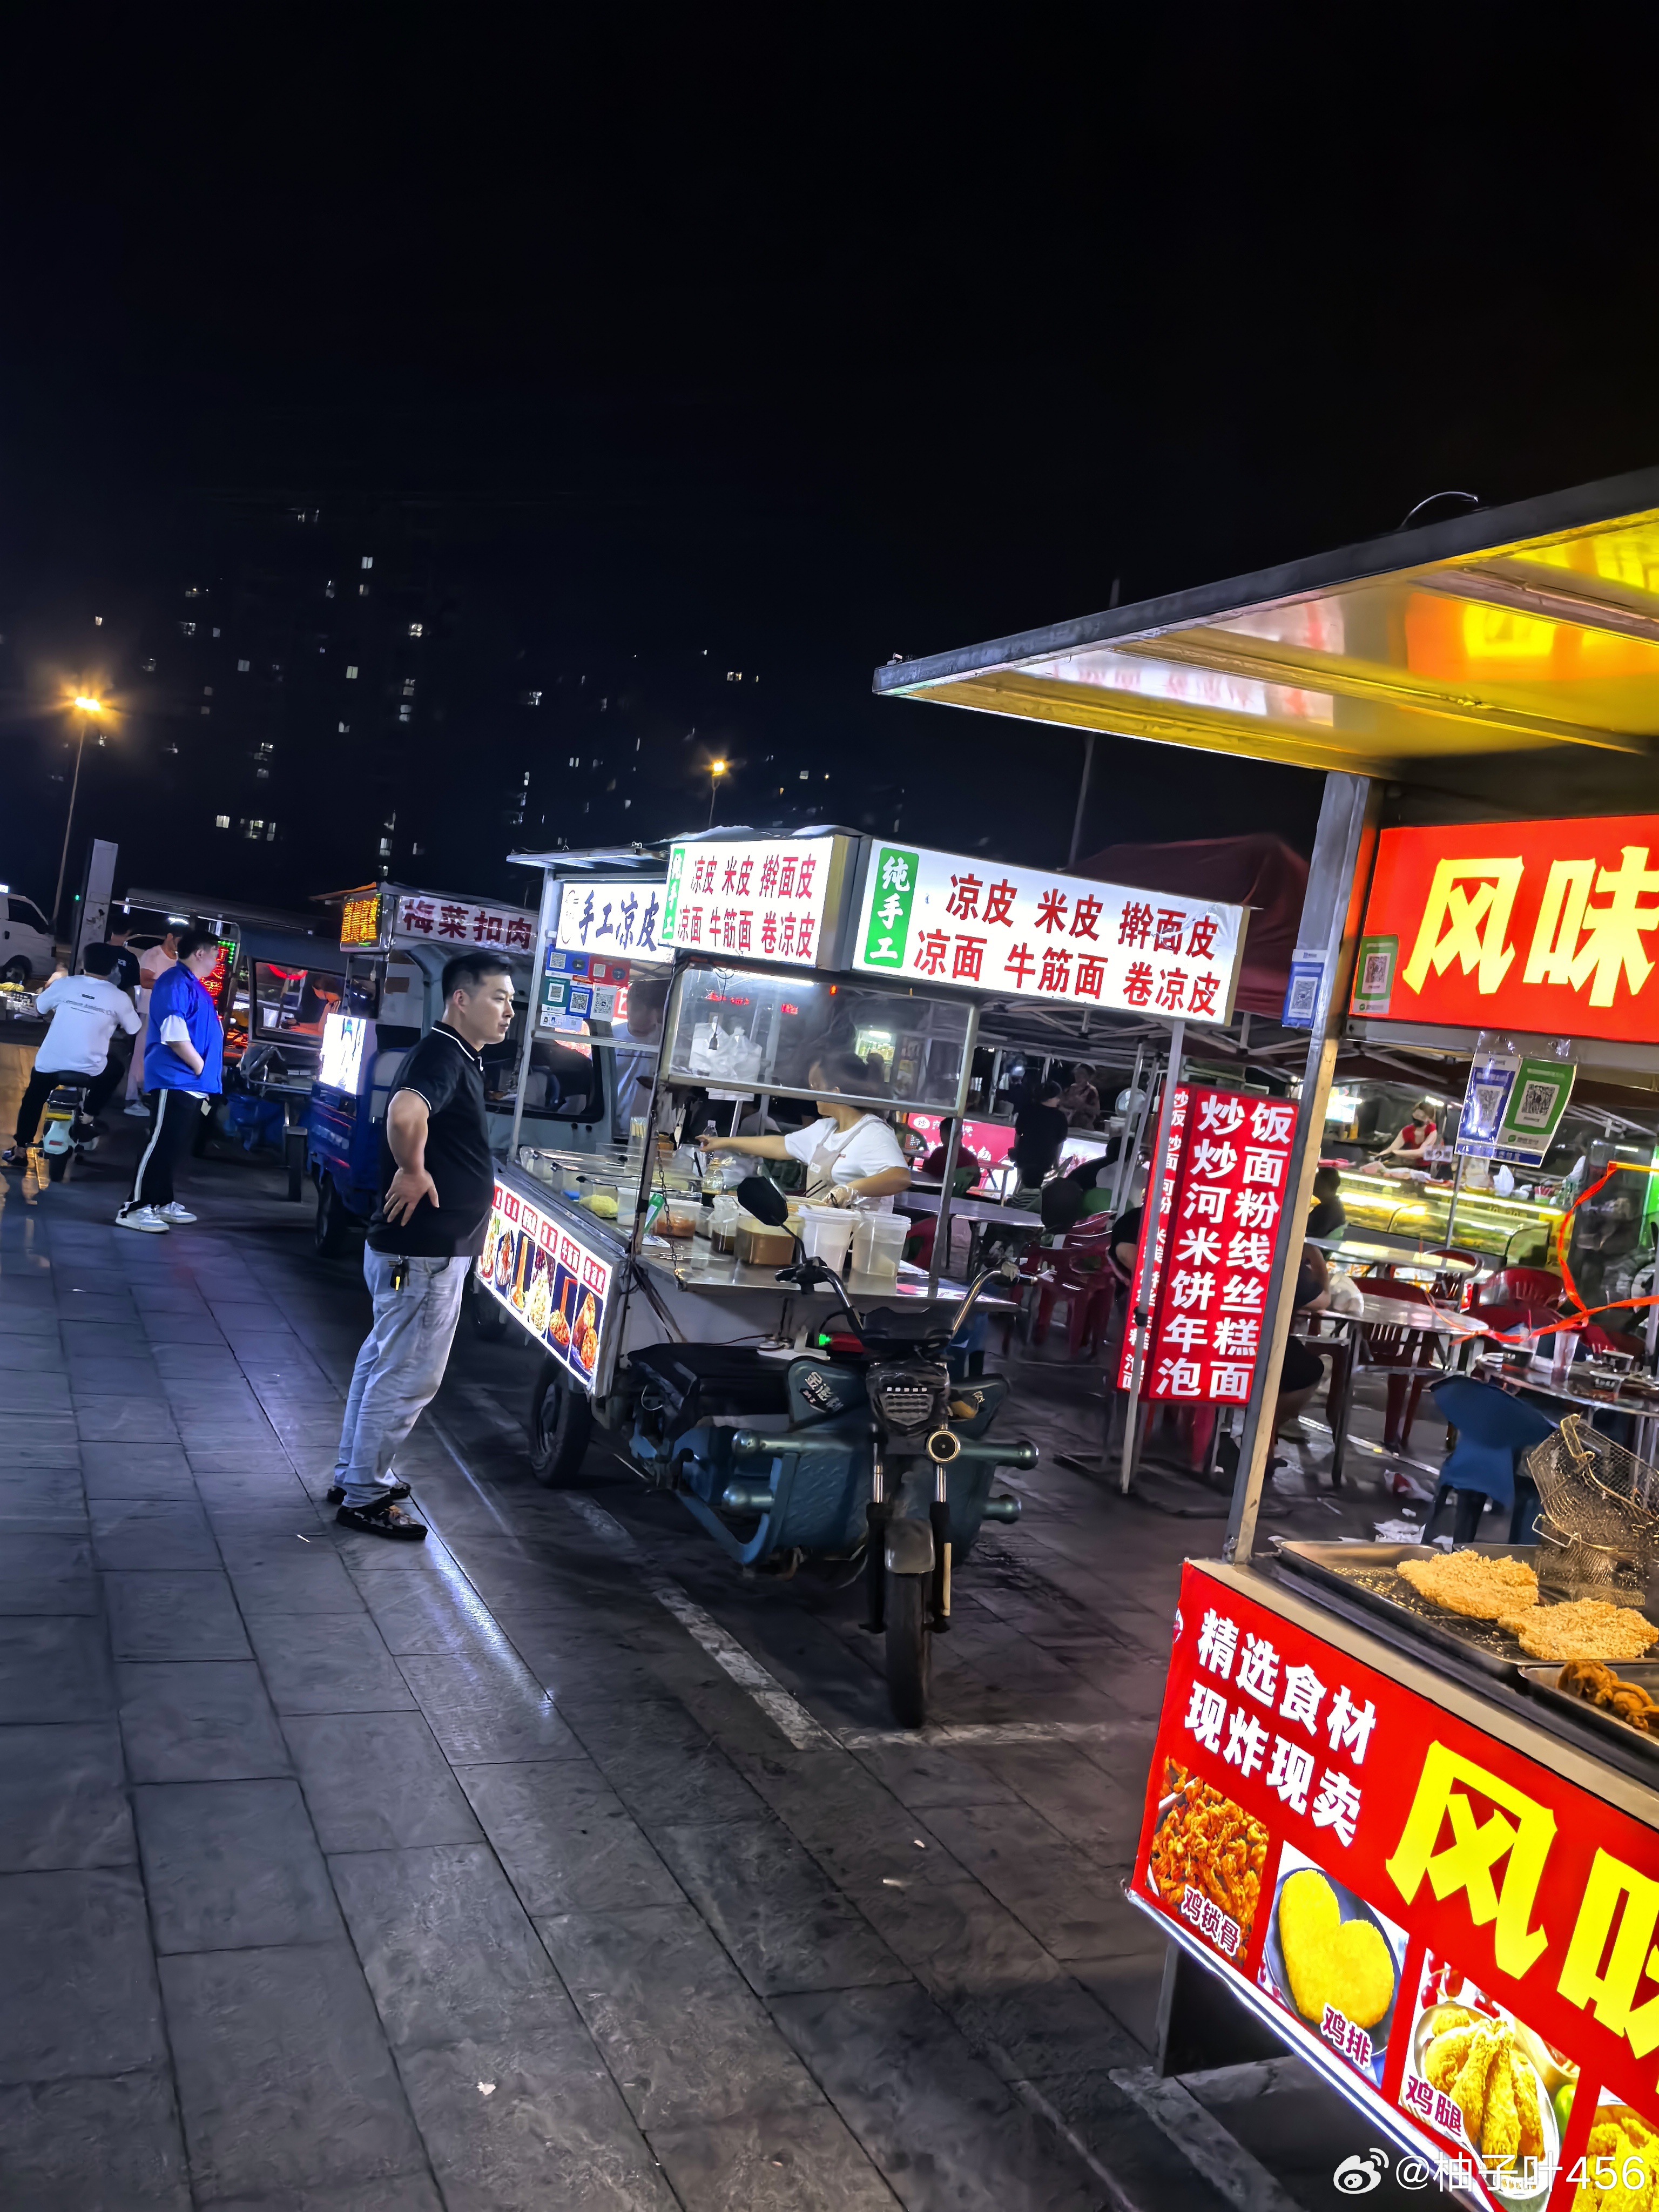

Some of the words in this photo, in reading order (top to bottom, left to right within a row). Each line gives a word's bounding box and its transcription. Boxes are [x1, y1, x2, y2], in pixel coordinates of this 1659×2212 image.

[722, 855, 754, 896] 米皮
[759, 853, 817, 899] 擀面皮
[403, 899, 532, 949] 梅菜扣肉
[579, 889, 659, 952] 手工凉皮
[709, 907, 753, 952] 牛筋面
[761, 911, 815, 959] 卷凉皮
[869, 855, 911, 960] 纯手工
[946, 873, 1017, 928] 凉皮
[1034, 888, 1104, 941] 米皮
[1118, 901, 1219, 961] 擀面皮
[1402, 846, 1659, 1007] 风味
[914, 929, 987, 982] 凉面
[1004, 942, 1108, 1000] 牛筋面
[1123, 962, 1220, 1017] 卷凉皮
[1198, 1095, 1294, 1144] 炒饭
[1190, 1138, 1288, 1187] 炒面
[1183, 1182, 1280, 1229] 河粉
[1176, 1226, 1271, 1273] 米线
[1171, 1269, 1264, 1313] 饼丝
[1163, 1313, 1259, 1356] 年糕
[1156, 1358, 1253, 1400] 泡面
[1197, 1607, 1377, 1764] 精选食材
[1184, 1680, 1362, 1847] 现炸现卖
[1182, 1886, 1239, 1955] 鸡锁骨
[1323, 2006, 1372, 2066] 鸡排
[1405, 2075, 1461, 2137] 鸡腿
